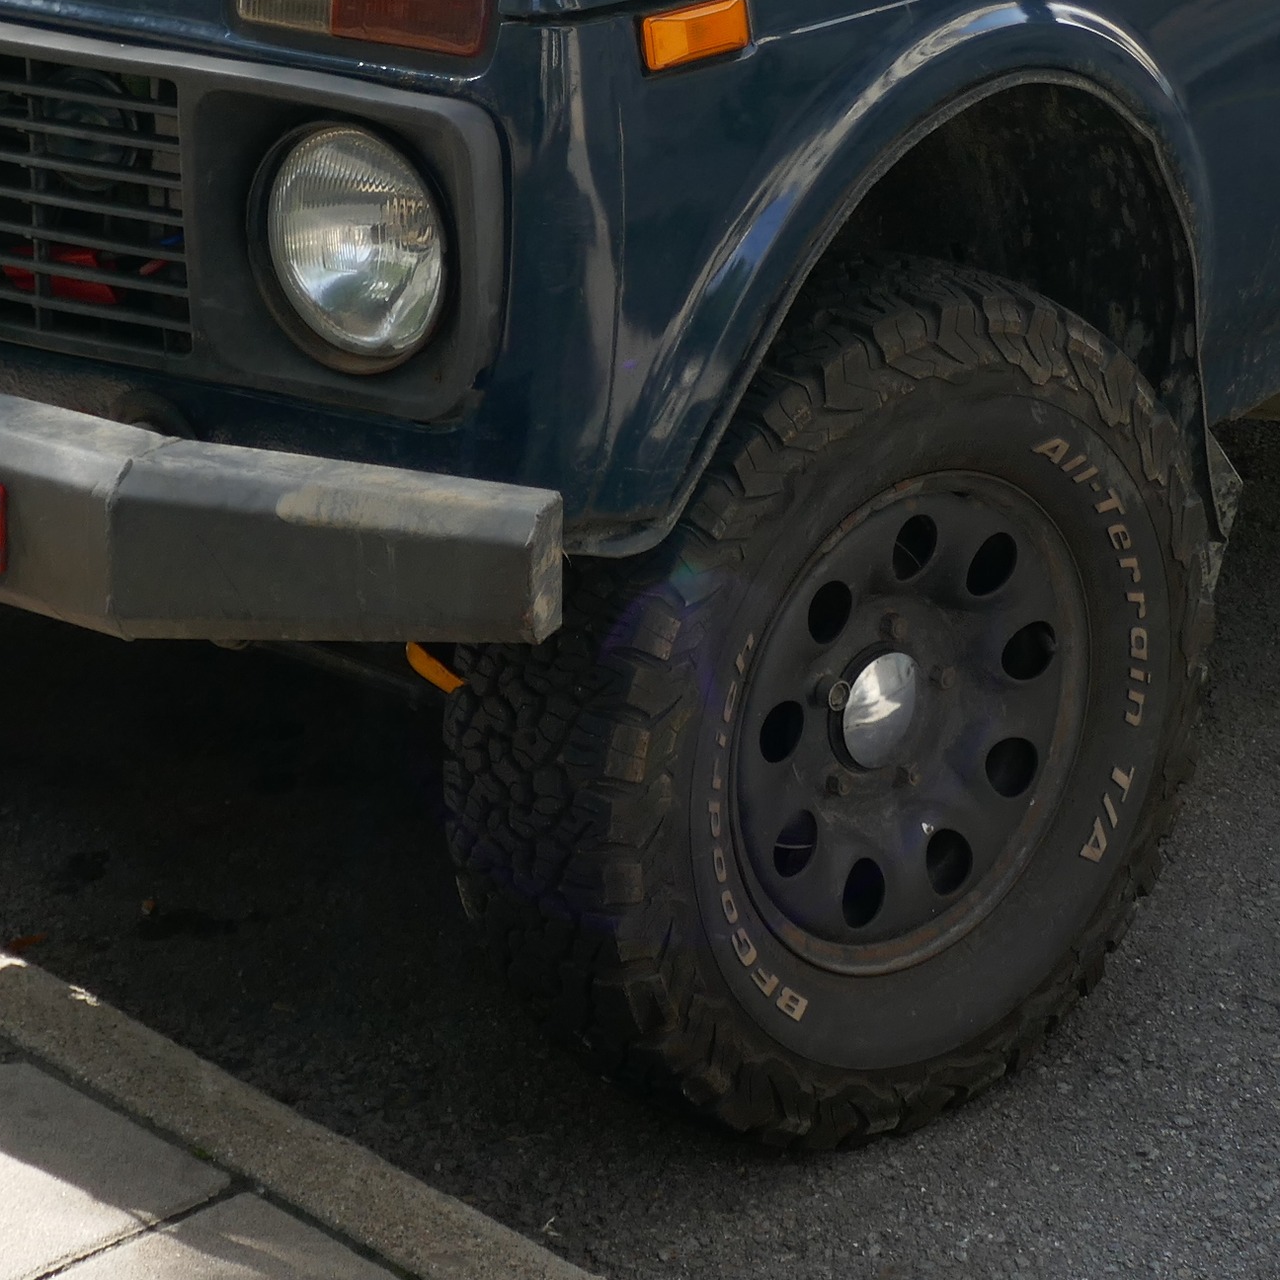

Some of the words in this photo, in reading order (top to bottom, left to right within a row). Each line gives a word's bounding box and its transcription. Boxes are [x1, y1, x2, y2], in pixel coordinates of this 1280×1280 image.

[1031, 436, 1152, 728] All-Terrain
[707, 632, 809, 1023] BFGoodrich
[1080, 765, 1135, 864] T/A
